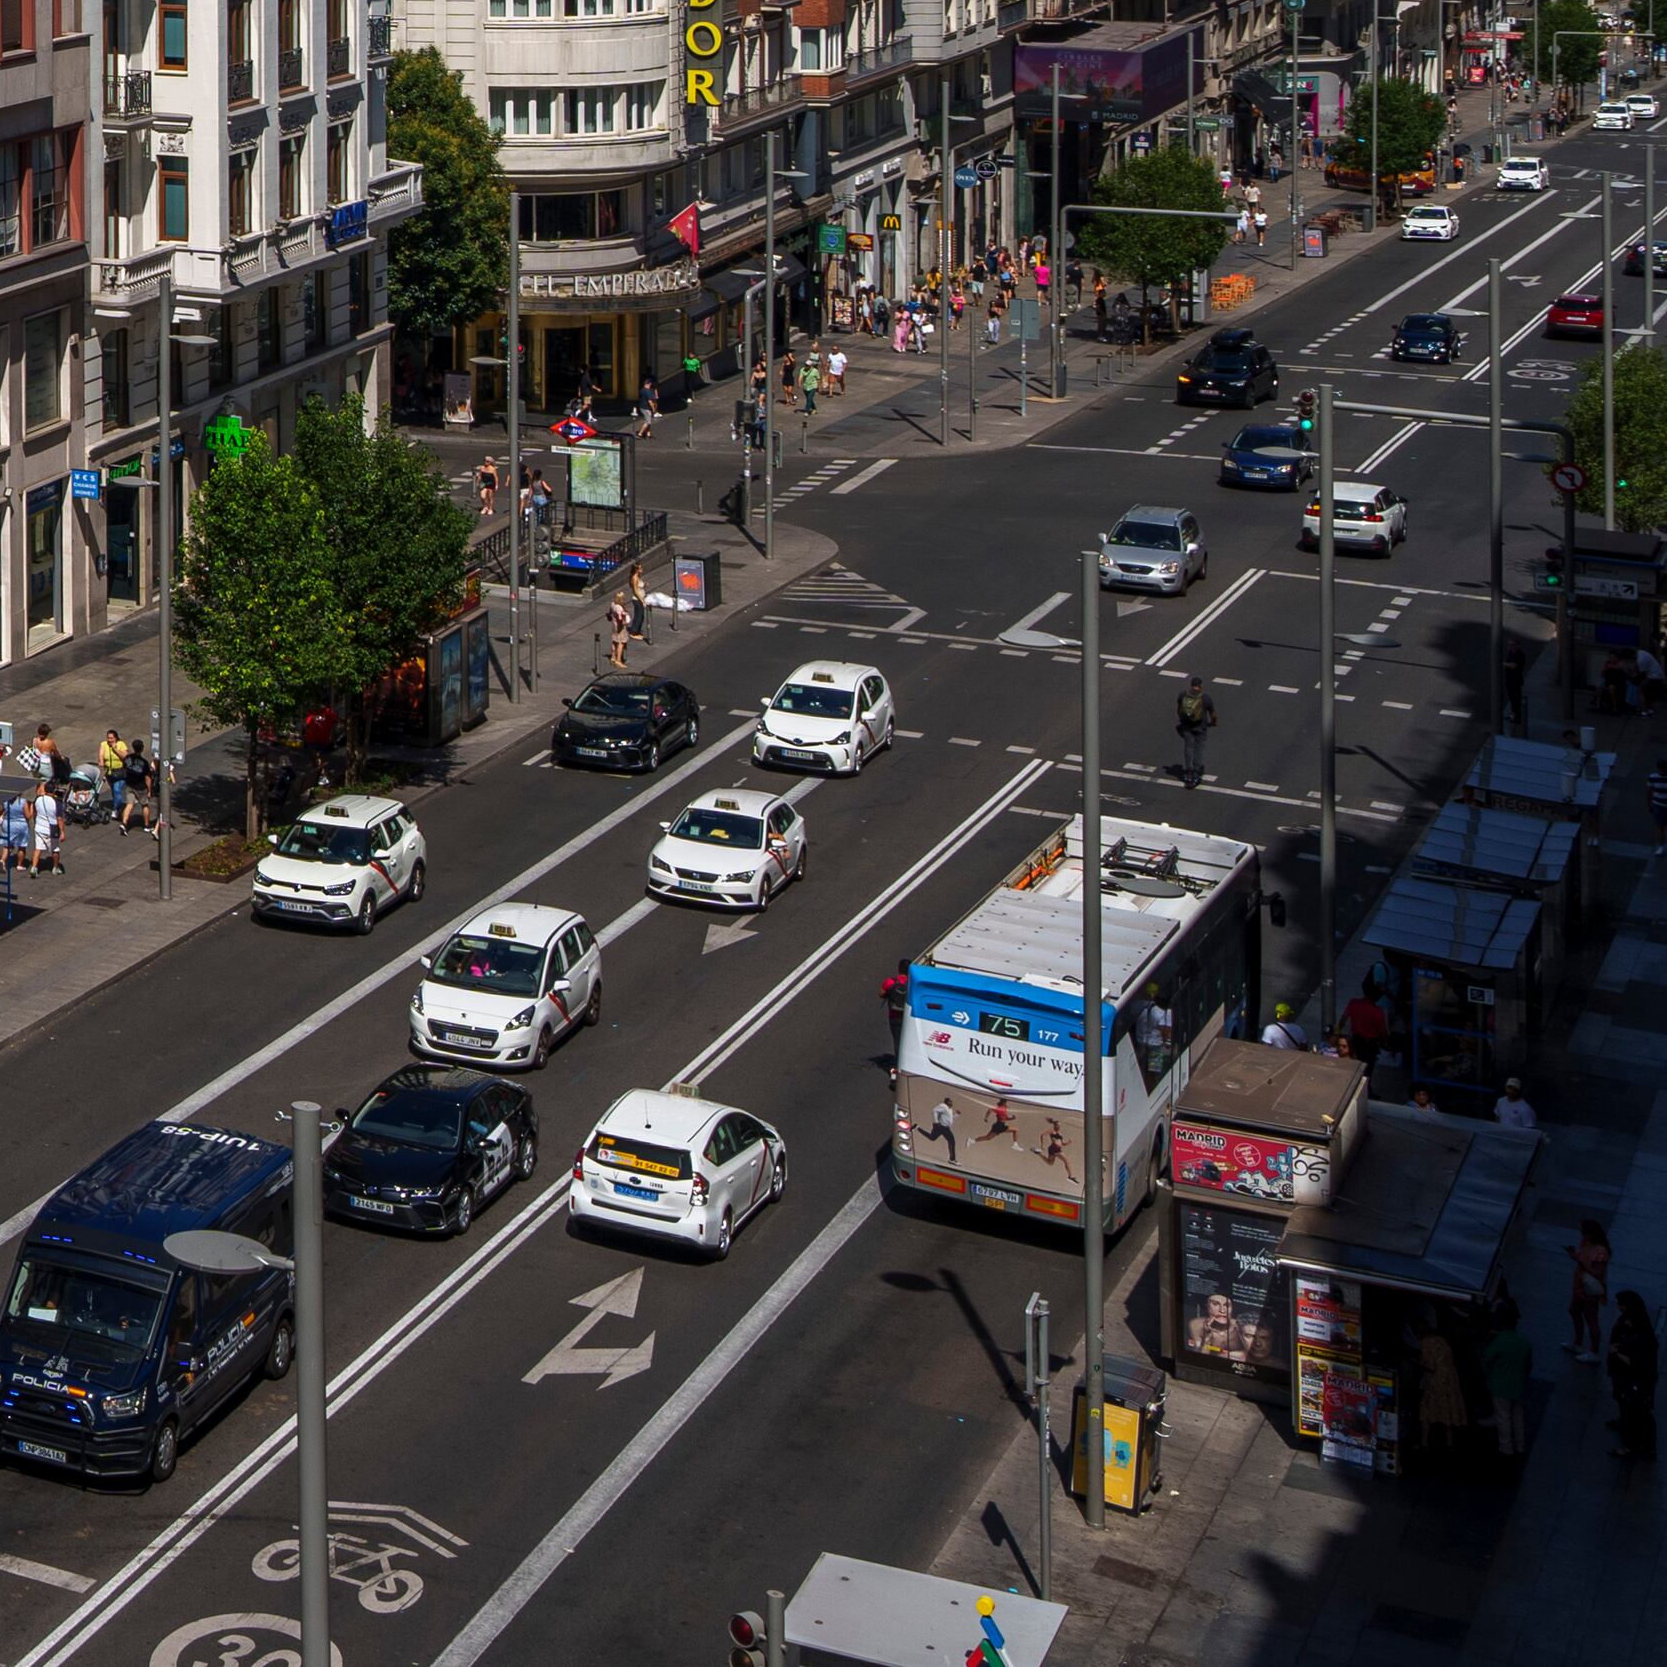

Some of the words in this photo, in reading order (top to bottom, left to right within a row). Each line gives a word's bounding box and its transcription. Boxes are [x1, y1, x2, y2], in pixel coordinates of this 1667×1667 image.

[1102, 111, 1139, 121] MADRID
[987, 1014, 1021, 1037] 75
[1037, 1029, 1060, 1043] 177
[968, 1037, 1003, 1060] Run
[1008, 1049, 1047, 1068] your
[161, 1125, 261, 1152] 1UIP-58
[1175, 1128, 1227, 1148] MADRID
[1233, 1251, 1276, 1267] Juguetes
[1239, 1262, 1269, 1274] Rotos
[1300, 1305, 1338, 1320] MADRID
[206, 1318, 247, 1363] POLICIA
[11, 1372, 70, 1394] POLICIA
